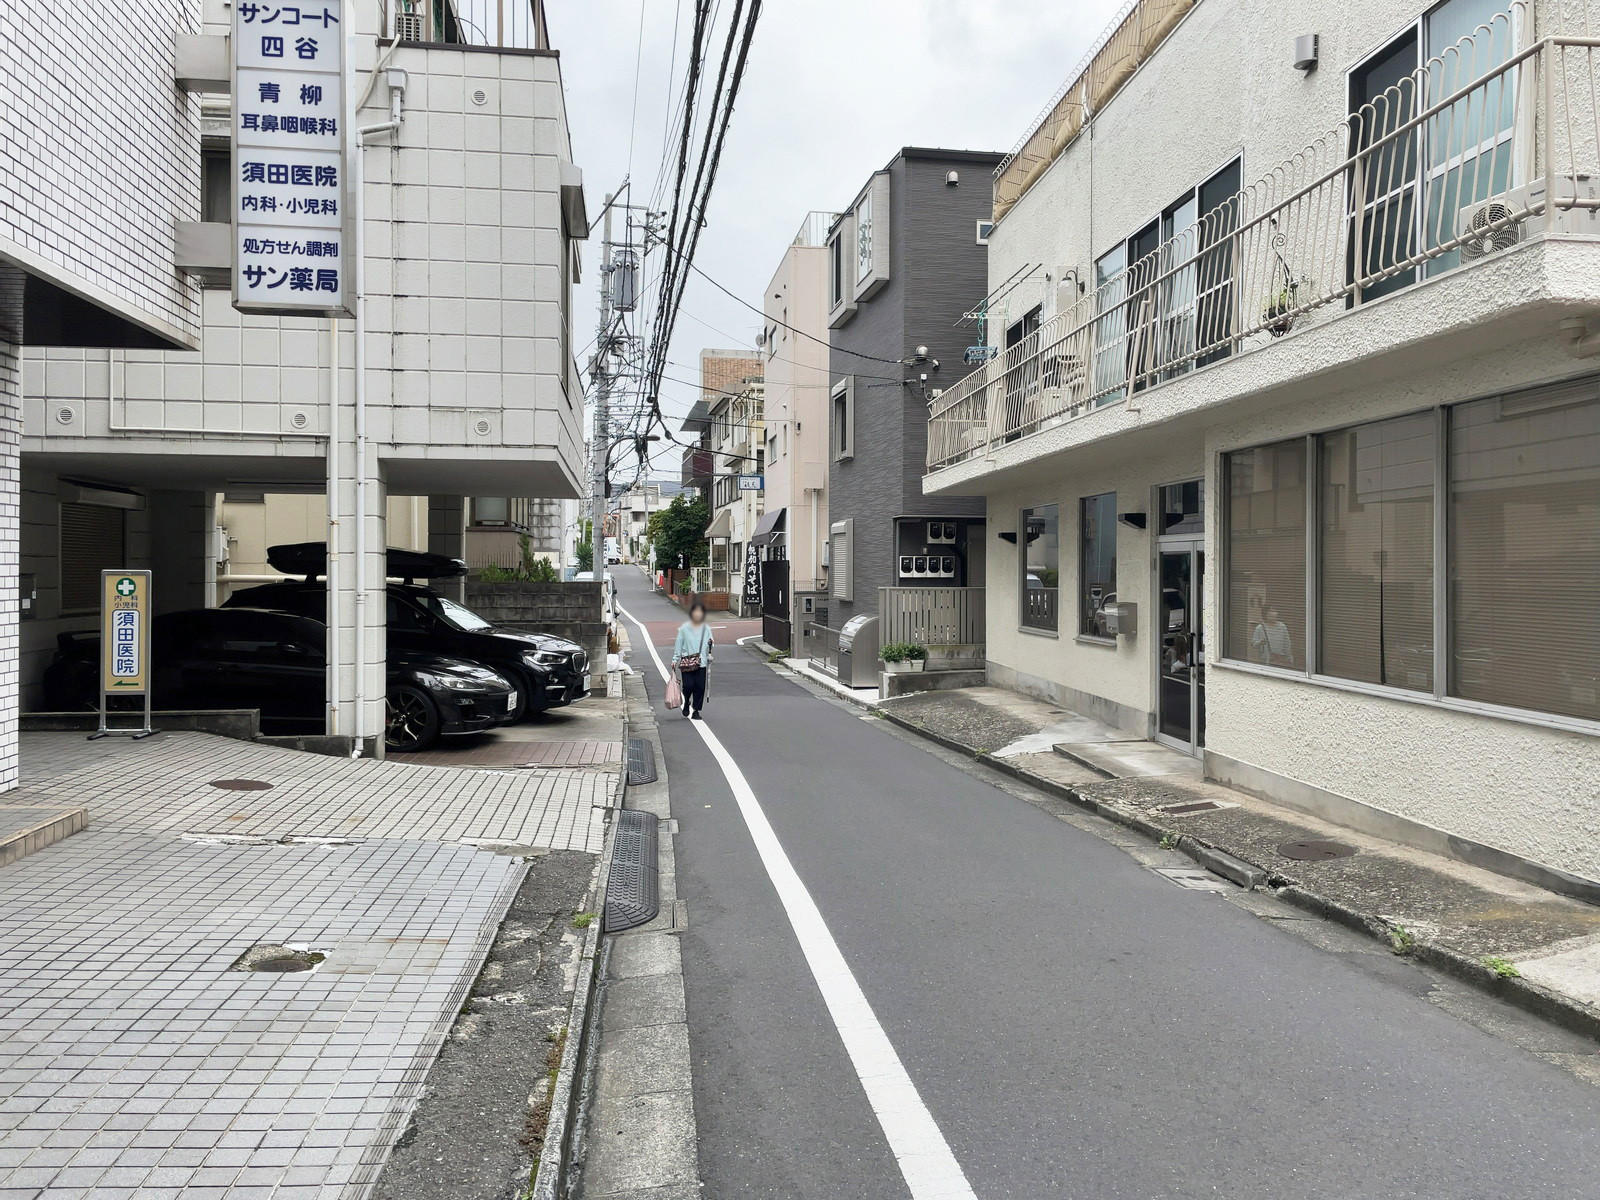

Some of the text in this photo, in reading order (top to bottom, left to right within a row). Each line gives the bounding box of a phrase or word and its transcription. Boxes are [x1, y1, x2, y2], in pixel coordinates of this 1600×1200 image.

[238, 2, 340, 28] サンコート
[261, 35, 319, 60] 四谷
[258, 82, 322, 106] 青柳
[240, 113, 338, 137] 耳鼻咽喉科
[241, 161, 337, 188] 須田医院
[241, 194, 338, 216] 内科・小児科
[242, 238, 339, 258] 処方せん調剤
[242, 264, 339, 293] サン薬局
[117, 612, 134, 673] 須田医院
